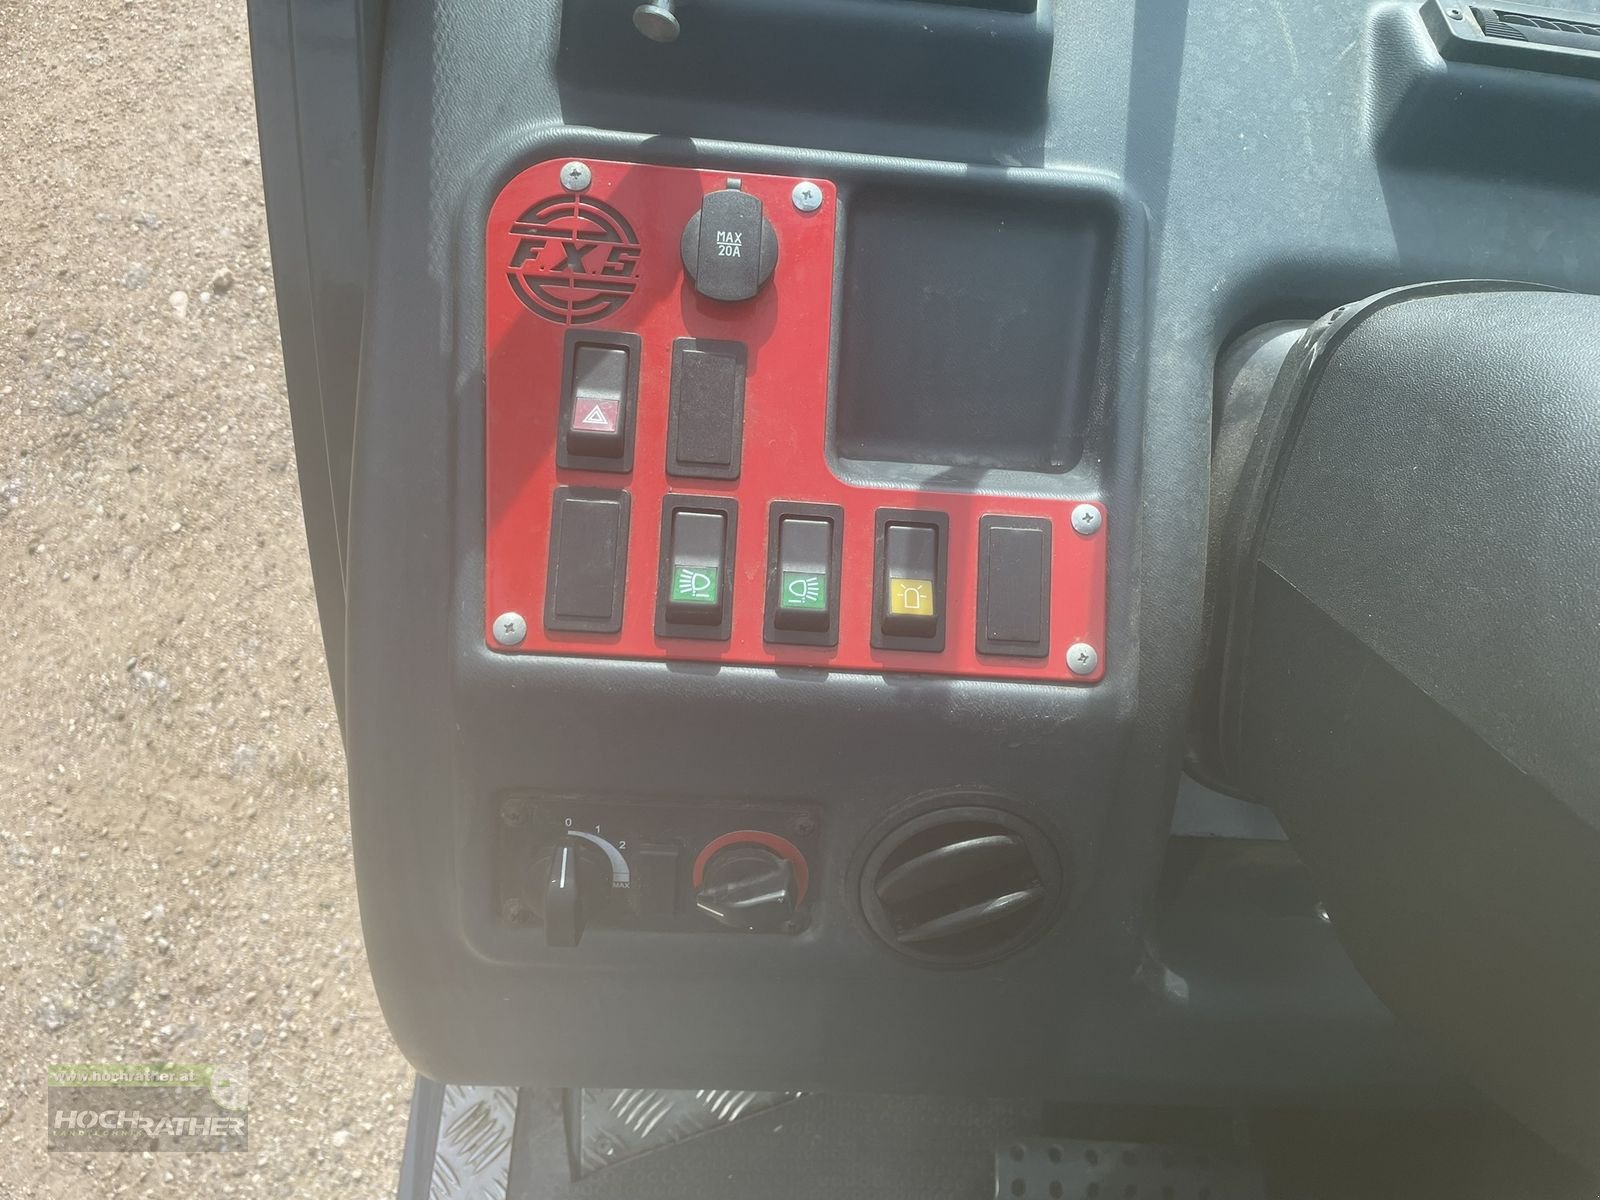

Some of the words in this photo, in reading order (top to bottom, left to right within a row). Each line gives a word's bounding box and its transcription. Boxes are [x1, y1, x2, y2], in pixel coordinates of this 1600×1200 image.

[716, 230, 742, 243] MAX
[718, 244, 741, 258] 20A
[564, 818, 573, 827] 0
[595, 825, 601, 833] 1
[619, 841, 626, 849] 2
